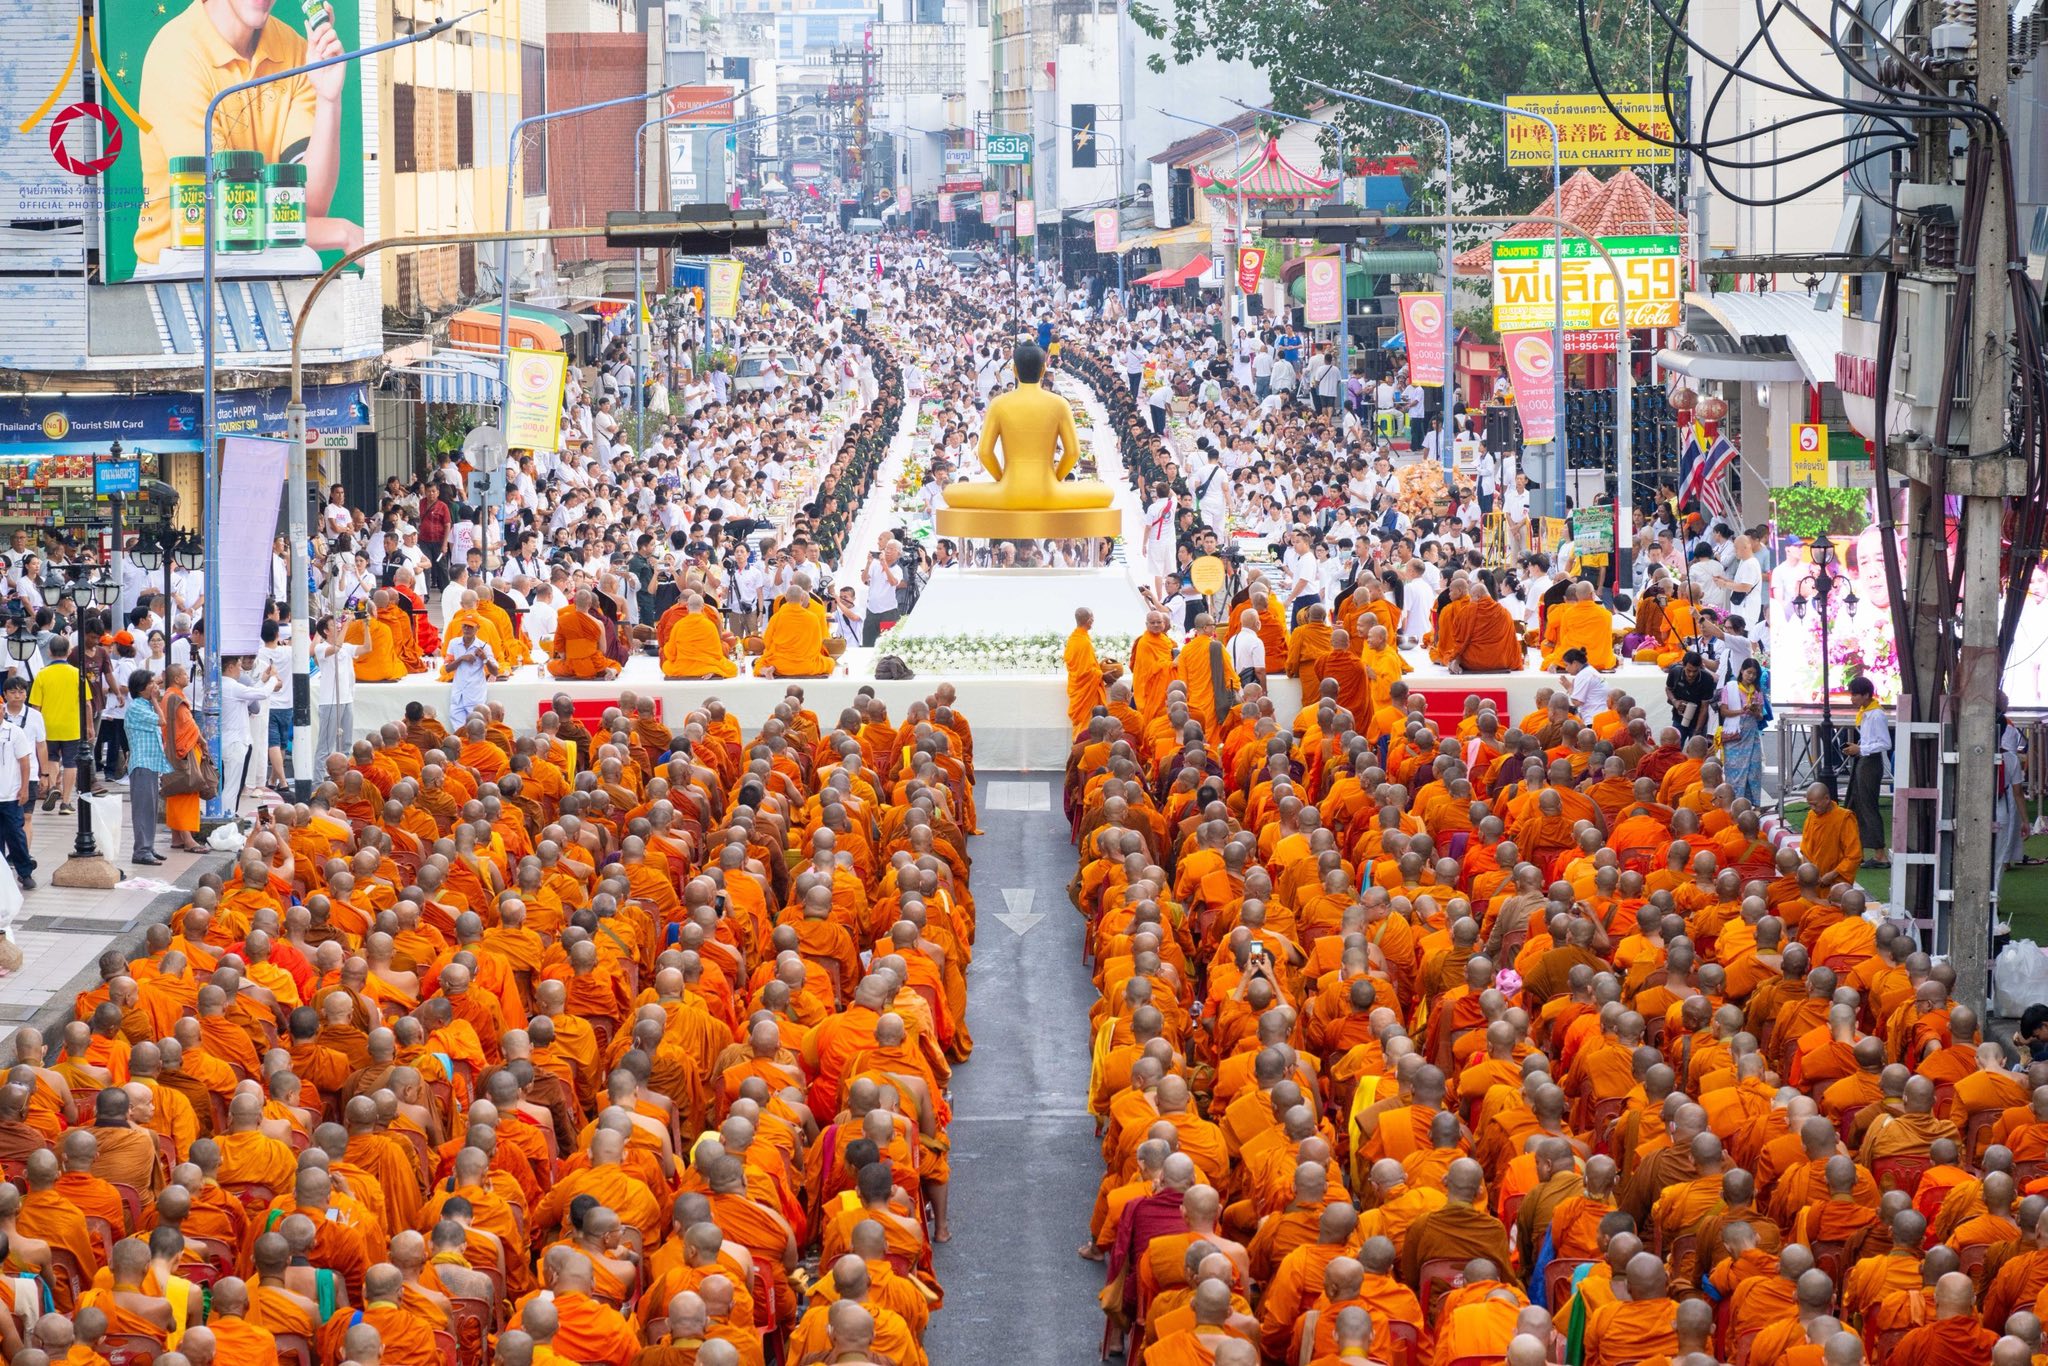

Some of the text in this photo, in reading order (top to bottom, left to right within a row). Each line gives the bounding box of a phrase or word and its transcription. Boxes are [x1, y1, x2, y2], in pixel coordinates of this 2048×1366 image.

[987, 137, 1029, 153] ศรีวิไล
[946, 150, 971, 164] ถ่ายรูป
[1510, 150, 1550, 160] ZHONG
[1582, 149, 1633, 159] CHARITY
[1636, 148, 1671, 158] HOME
[783, 251, 793, 263] D
[915, 258, 925, 270] A
[1627, 258, 1676, 300] 59
[1599, 303, 1673, 326] Coa-Cola
[1544, 320, 1590, 329] 0745-746
[1563, 333, 1621, 342] 81-897-116
[1563, 342, 1618, 351] 81-956-44
[179, 405, 195, 414] dtac
[217, 405, 257, 420] dtac HAPPY
[0, 422, 43, 431] Thailand's
[71, 421, 102, 430] Tourist
[103, 420, 121, 429] SIM
[122, 420, 144, 430] Card
[168, 416, 196, 432] 5G
[218, 419, 258, 432] TOURIST SIM
[324, 435, 348, 447] นวดตัว
[1794, 457, 1825, 474] จุดต้อนรับ
